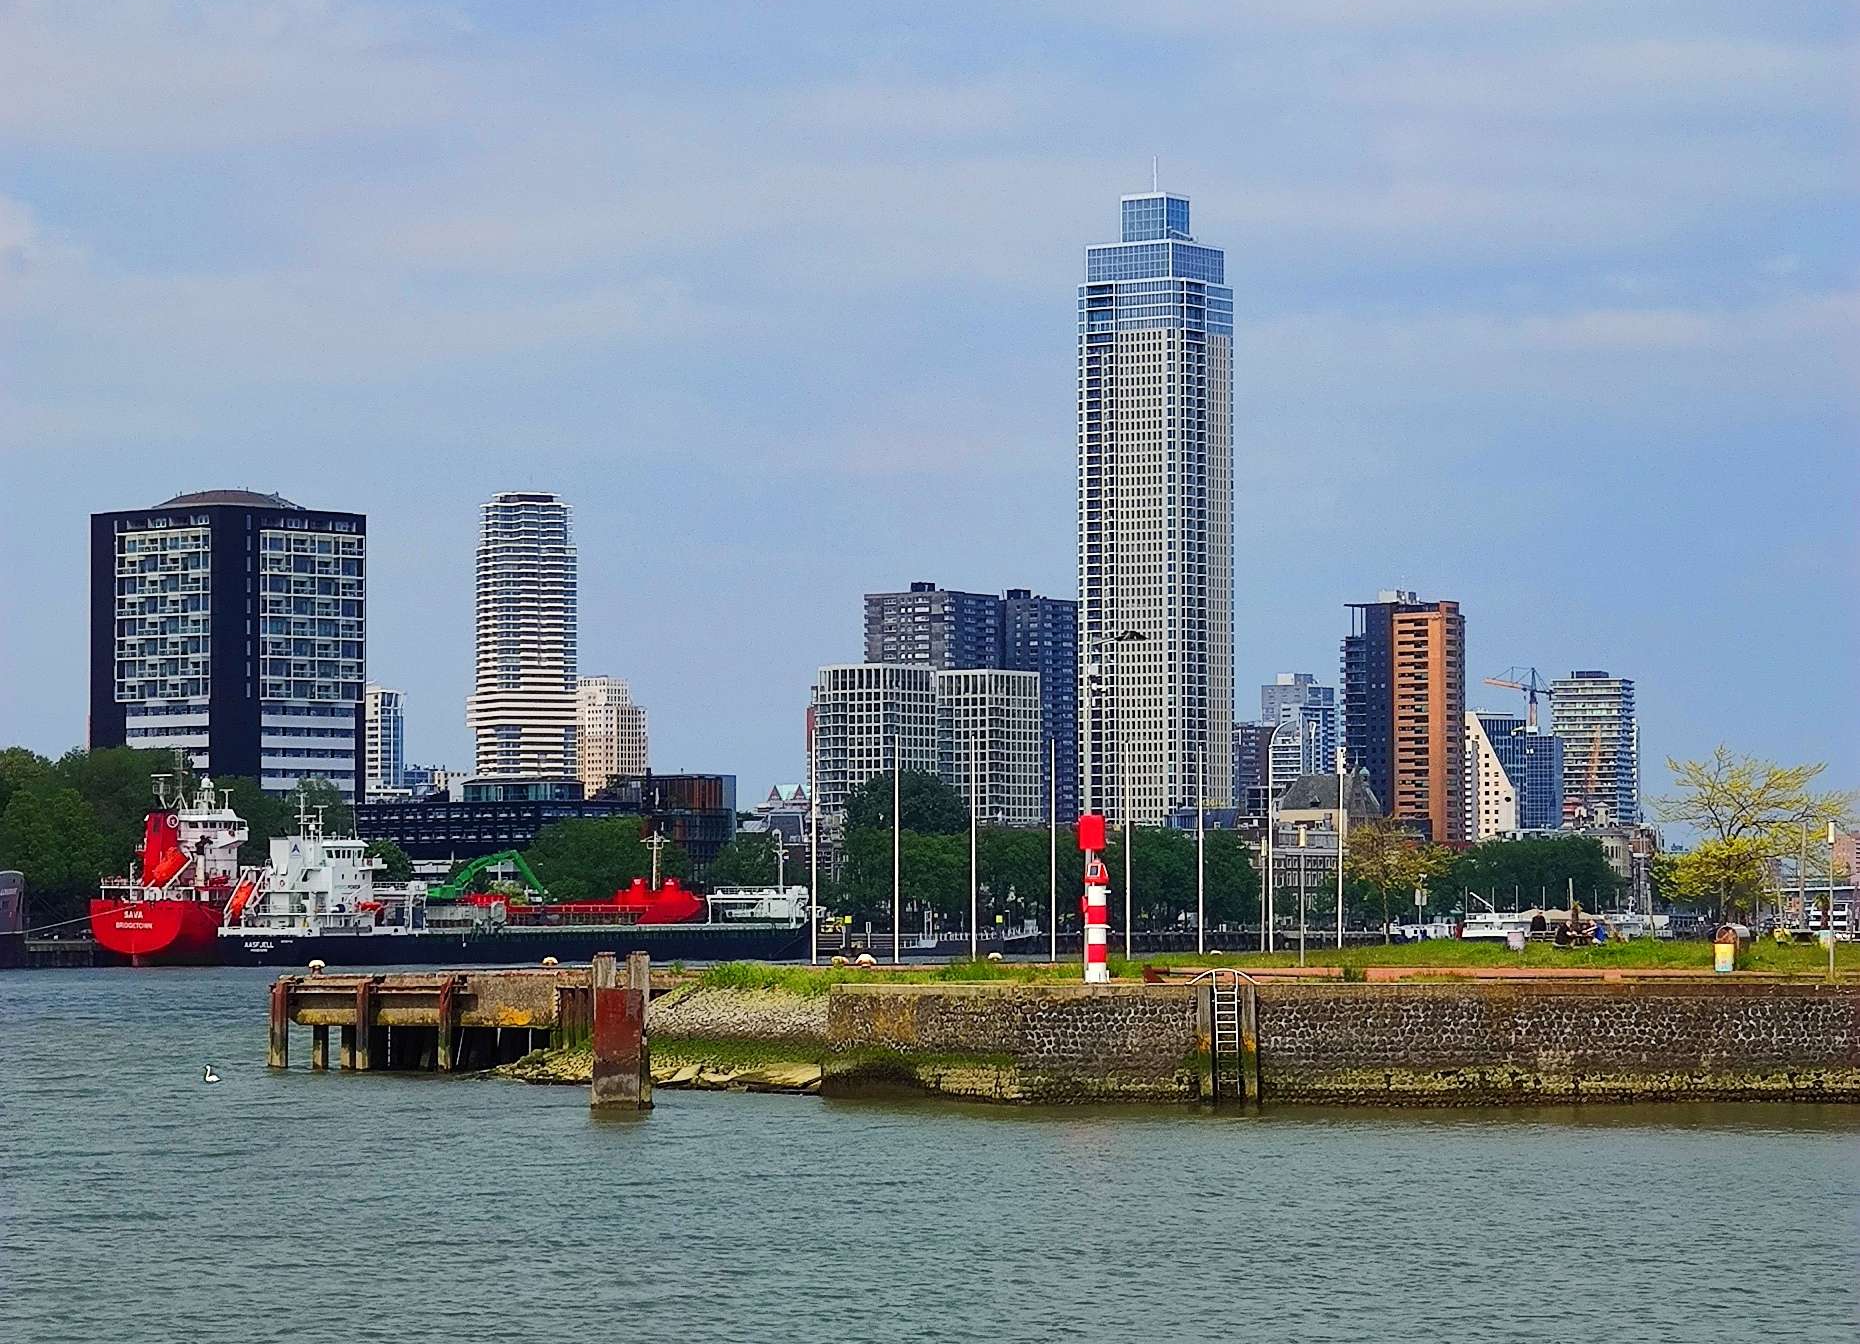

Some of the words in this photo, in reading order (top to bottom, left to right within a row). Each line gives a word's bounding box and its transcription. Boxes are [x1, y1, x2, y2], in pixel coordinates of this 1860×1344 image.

[123, 910, 144, 919] SAVA
[115, 921, 153, 929] BRIDGETOWN
[243, 941, 275, 949] AASFJELL
